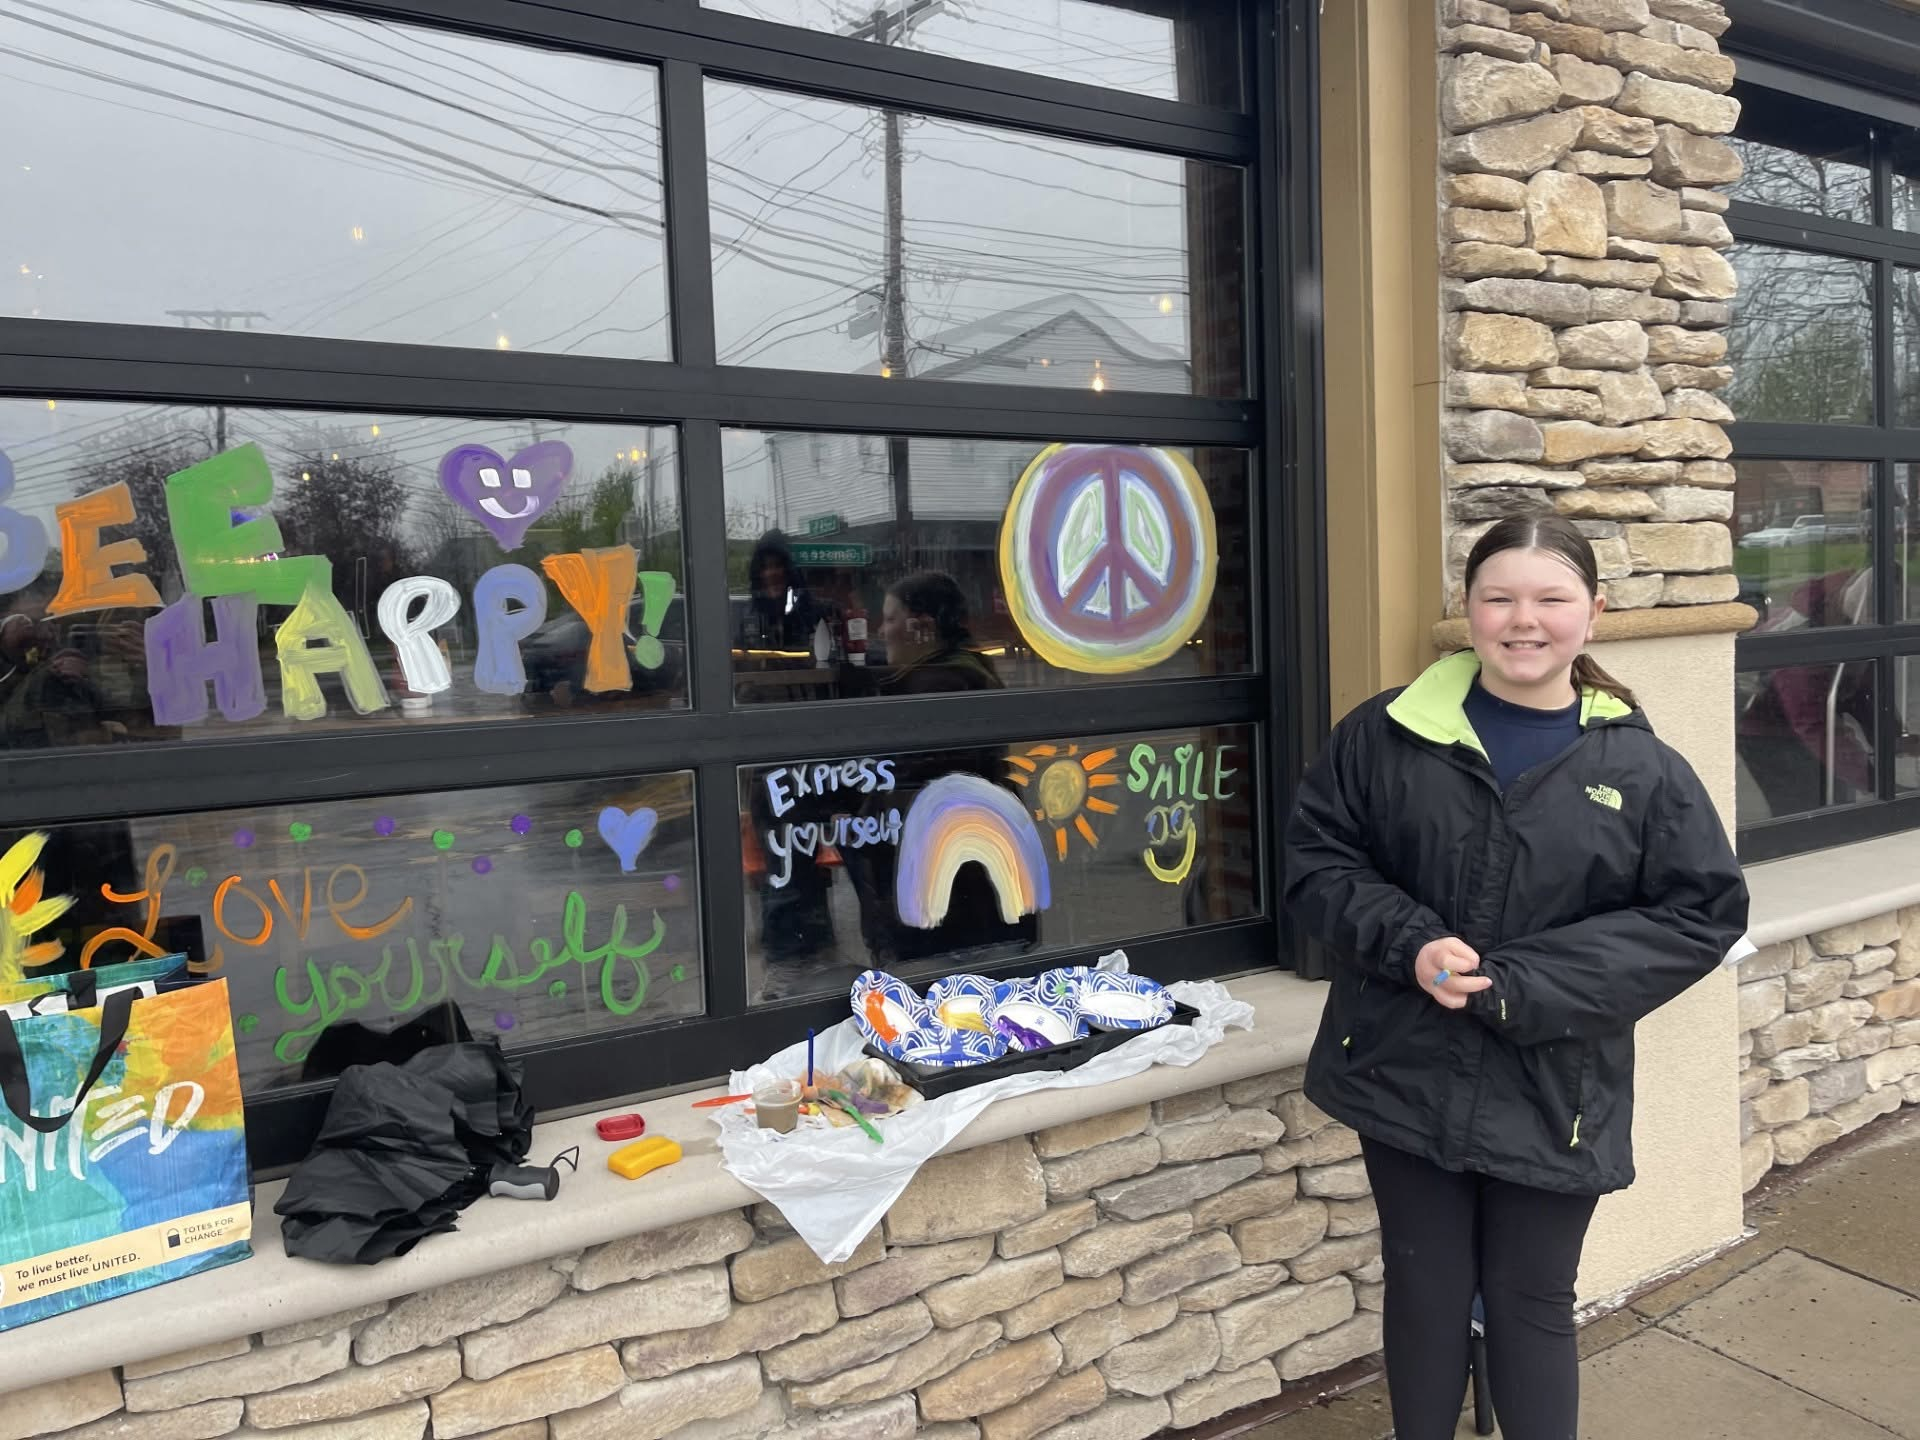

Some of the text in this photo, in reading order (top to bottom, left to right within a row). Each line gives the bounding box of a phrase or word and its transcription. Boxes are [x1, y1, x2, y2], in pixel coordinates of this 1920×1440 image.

[144, 544, 675, 726] HAPPY!
[1585, 786, 1611, 799] NORTH
[1589, 793, 1609, 805] FACE
[80, 843, 413, 974] Love
[273, 890, 664, 1064] yourself
[183, 1217, 234, 1235] TOTES FOR
[184, 1229, 223, 1244] CHANGE
[16, 1254, 92, 1280] To live better,
[17, 1252, 141, 1292] we must live UNITED.
